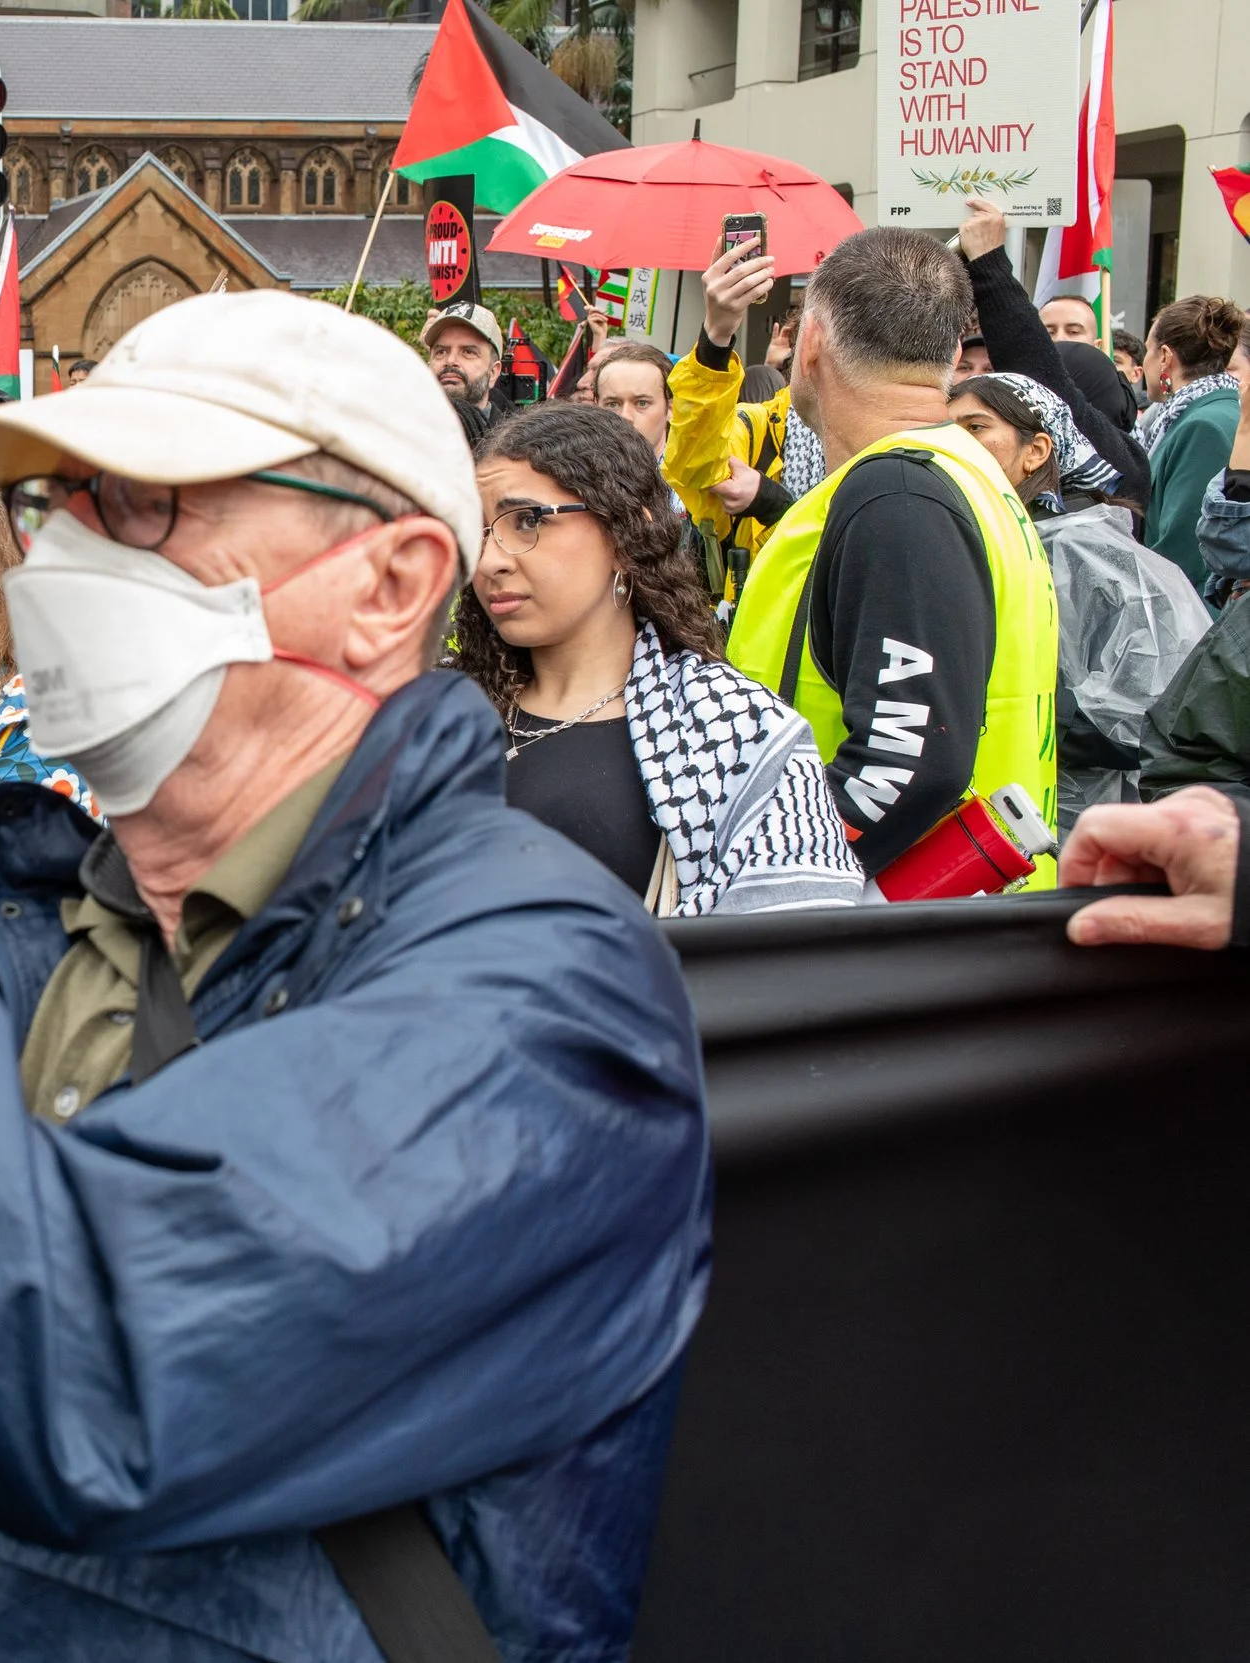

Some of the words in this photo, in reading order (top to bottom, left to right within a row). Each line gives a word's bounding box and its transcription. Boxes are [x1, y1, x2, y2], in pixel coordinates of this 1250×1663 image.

[900, 28, 922, 57] IS
[927, 24, 965, 54] TO
[899, 57, 988, 90] STAND
[899, 92, 966, 123] WITH
[900, 123, 1035, 156] HUMANITY
[890, 206, 911, 216] FPP
[430, 222, 458, 240] PROUD
[429, 239, 458, 265] ANTI
